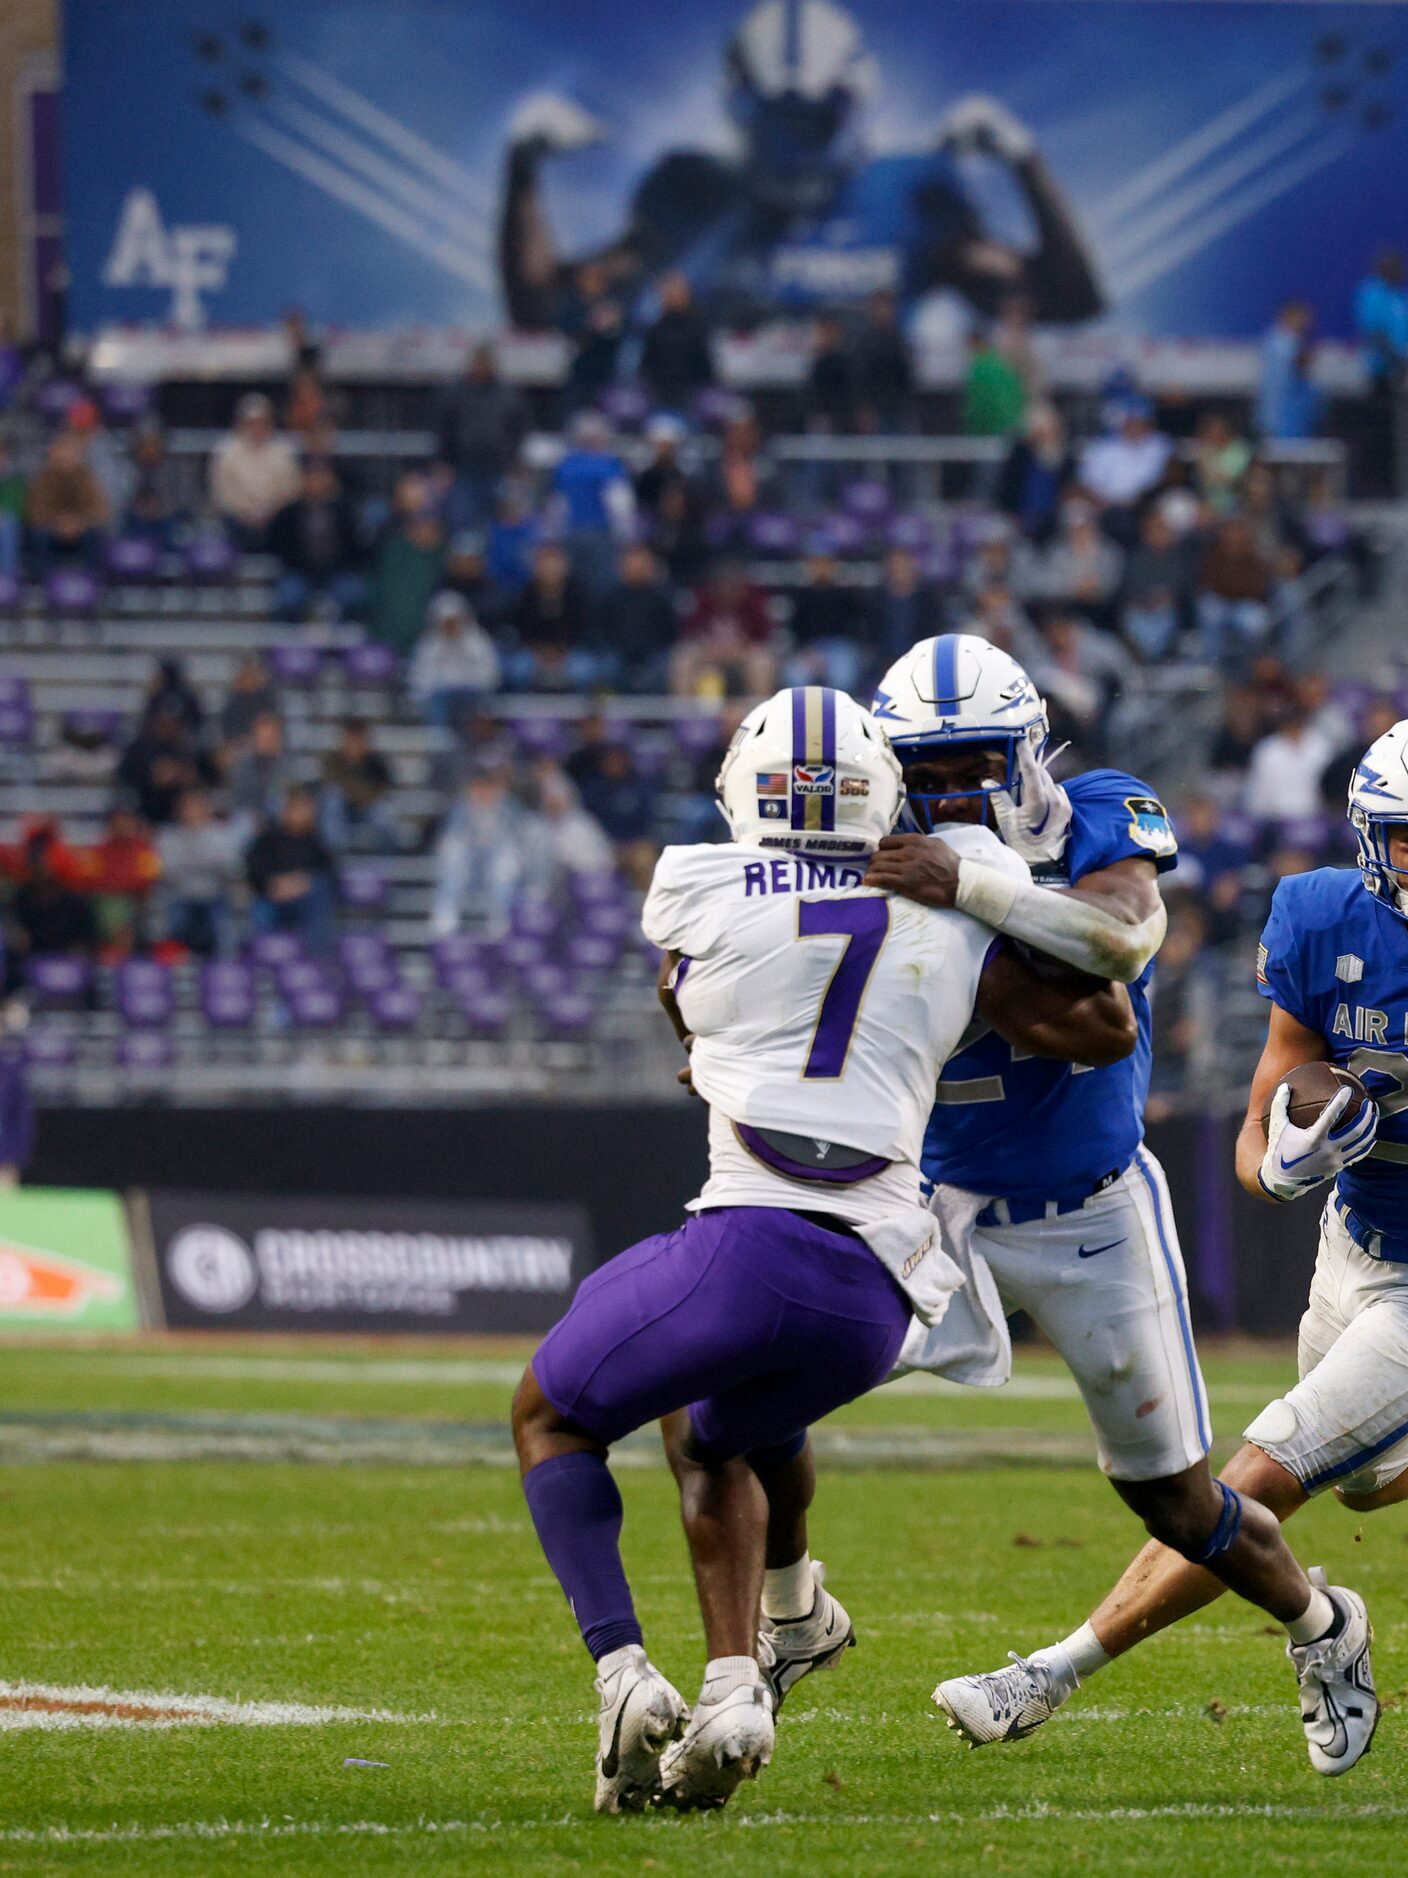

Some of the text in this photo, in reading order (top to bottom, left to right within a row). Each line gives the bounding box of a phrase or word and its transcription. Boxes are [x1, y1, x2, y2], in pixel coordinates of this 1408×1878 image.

[104, 187, 237, 327] AF
[796, 785, 832, 794] VALOR
[759, 837, 800, 848] JAMES
[794, 893, 895, 1083] 7
[1332, 1003, 1389, 1045] AIR
